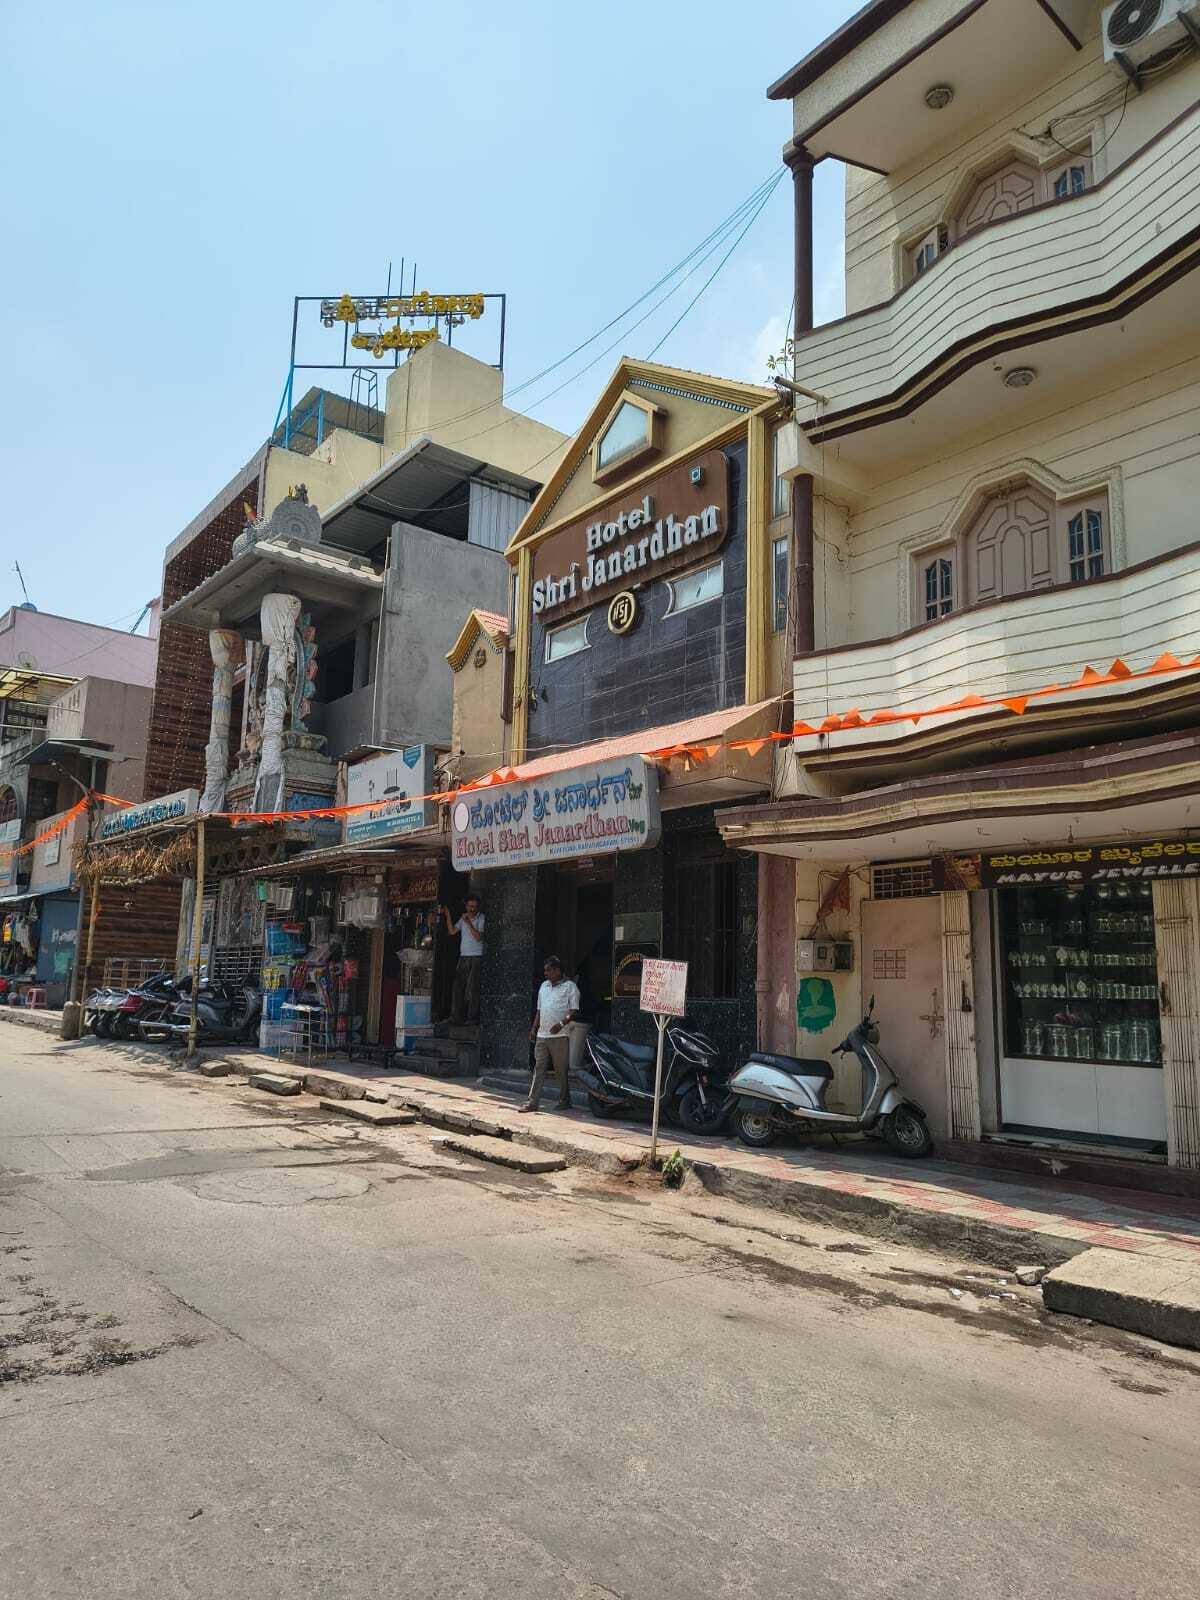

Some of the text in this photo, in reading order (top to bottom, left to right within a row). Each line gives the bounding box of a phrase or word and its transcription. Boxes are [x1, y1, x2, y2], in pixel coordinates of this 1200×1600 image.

[585, 495, 655, 552] Hotel
[532, 504, 720, 615] Shri Janardhan
[532, 788, 551, 823] ಶ್ರೀ
[456, 832, 494, 859] Hotel
[499, 826, 530, 853] Shri
[534, 812, 630, 847] Janardhan
[628, 818, 645, 834] Veg
[990, 848, 1092, 867] ಮಯೂರ
[996, 870, 1083, 884] MAYUR
